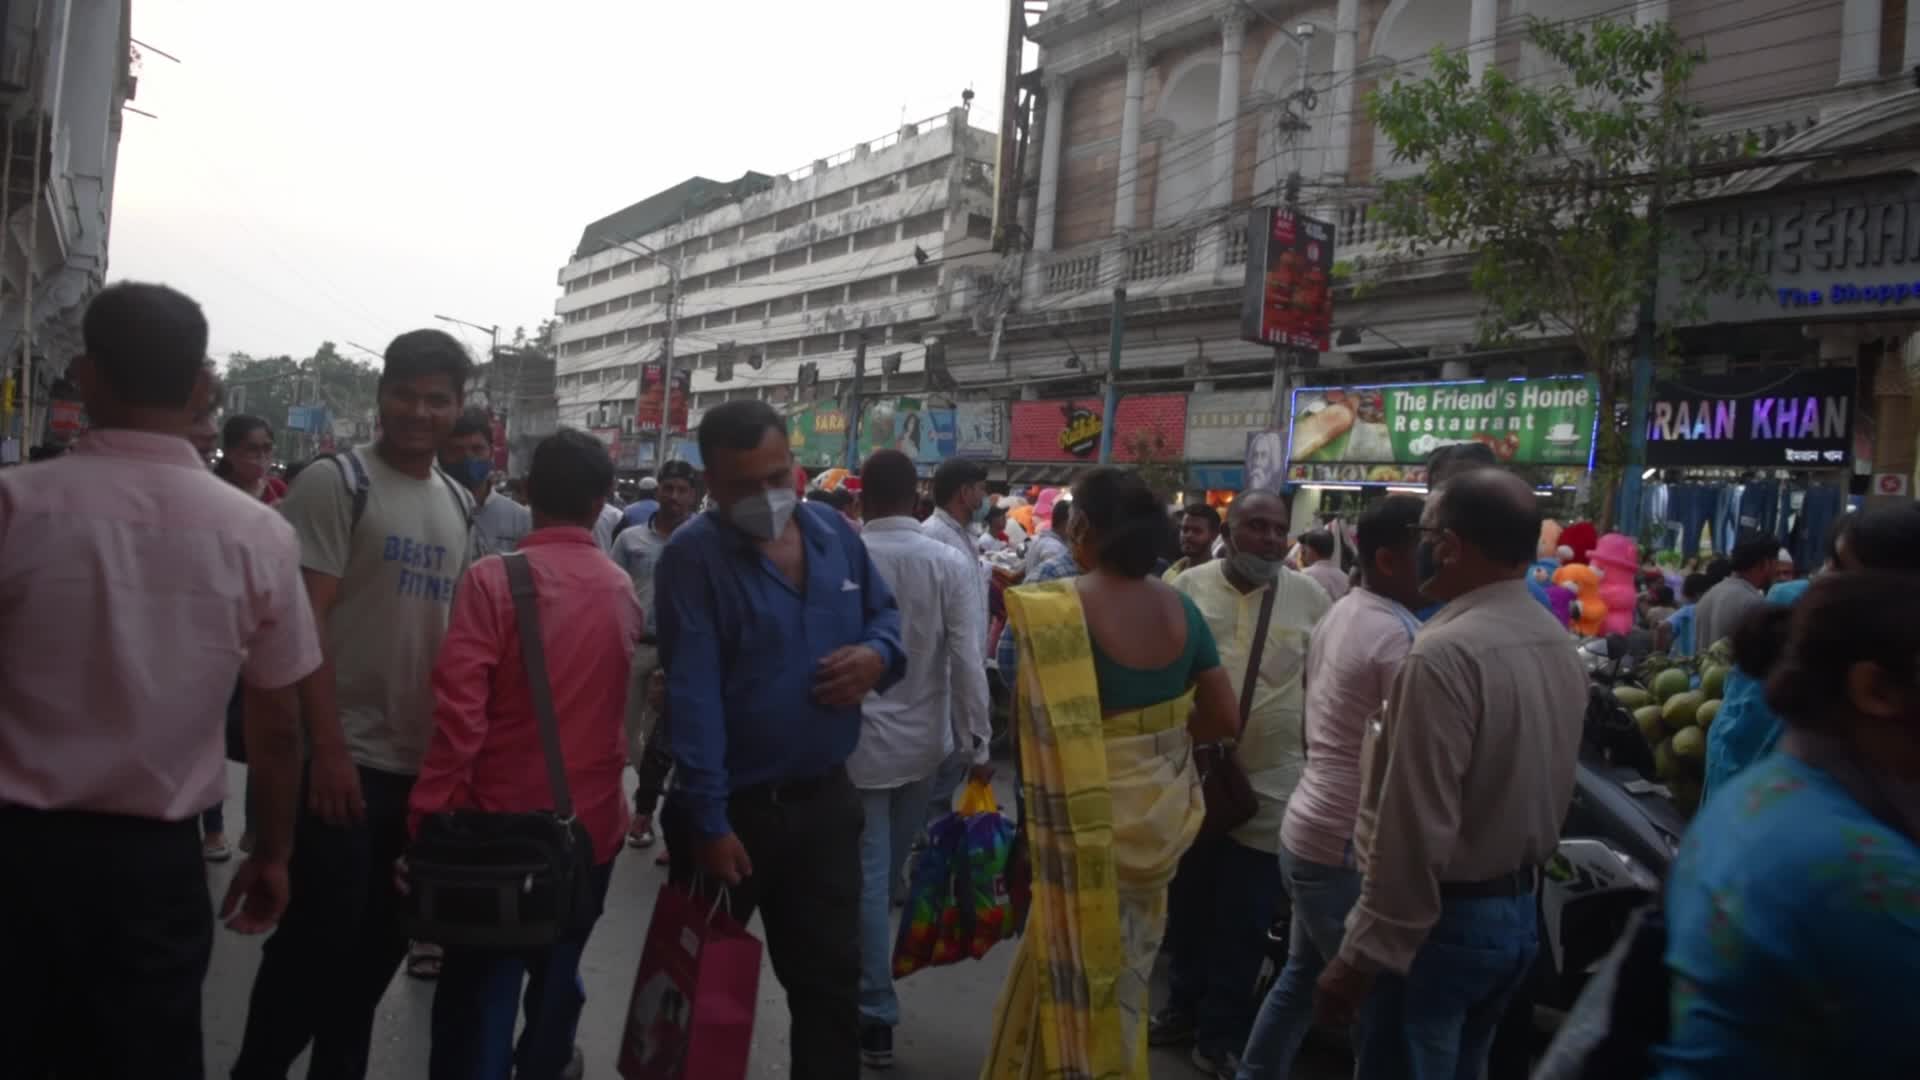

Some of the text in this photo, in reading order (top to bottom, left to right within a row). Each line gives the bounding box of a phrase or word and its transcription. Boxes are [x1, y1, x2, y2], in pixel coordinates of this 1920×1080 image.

[1682, 194, 1920, 284] SHREERA
[1778, 286, 1823, 306] The
[1394, 385, 1589, 411] The Friend's Home
[1394, 412, 1535, 432] Restaurant
[1751, 395, 1849, 440] KHAN
